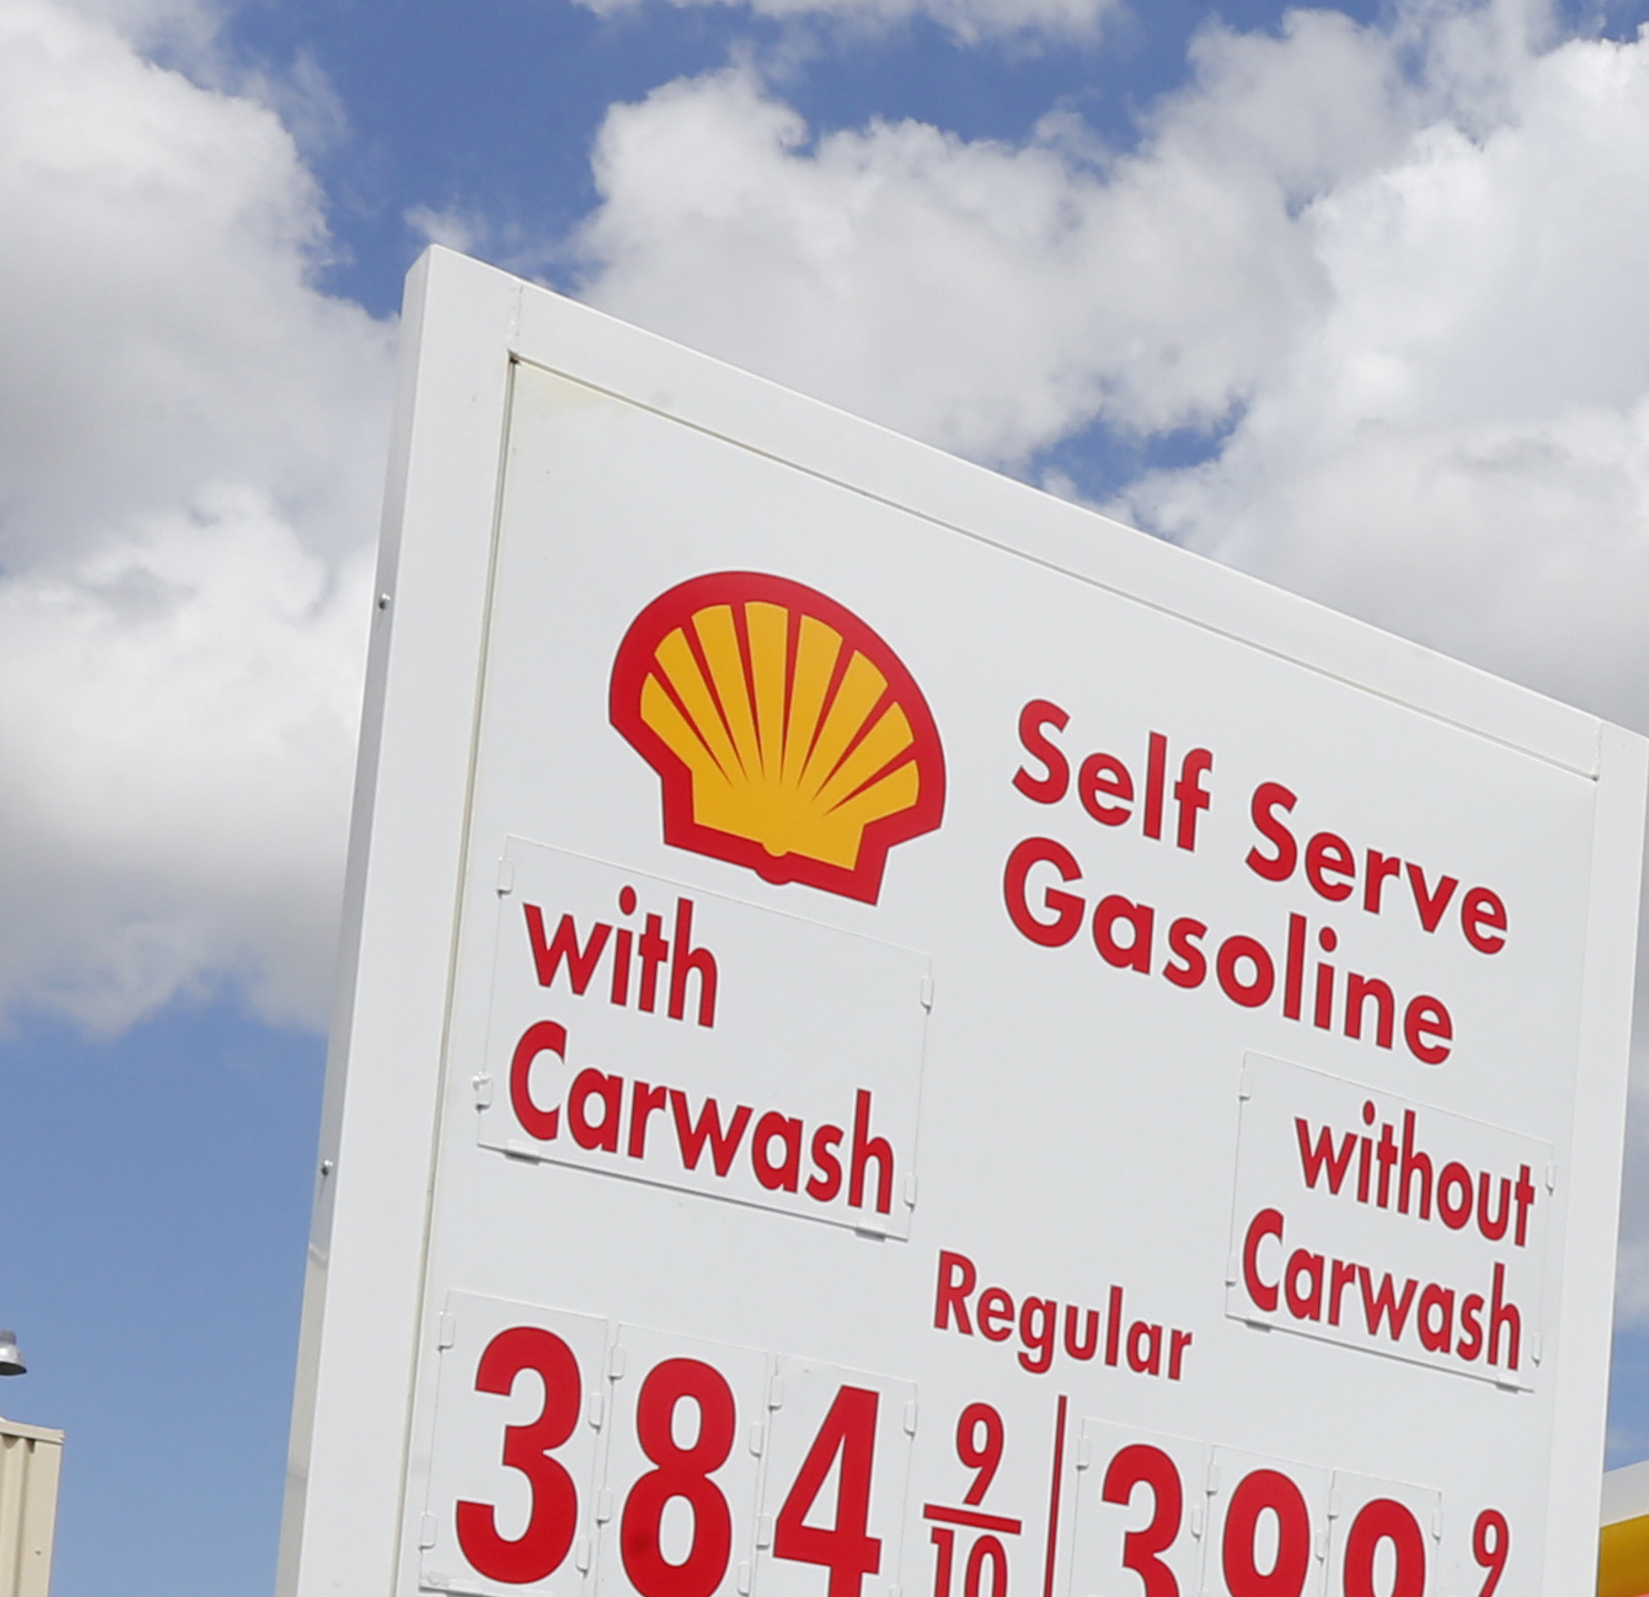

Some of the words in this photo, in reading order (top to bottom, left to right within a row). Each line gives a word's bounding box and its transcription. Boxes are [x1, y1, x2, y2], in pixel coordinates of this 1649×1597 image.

[1012, 698, 1213, 852] Self
[1245, 780, 1508, 955] Serve
[523, 885, 719, 1029] with
[1003, 836, 1454, 1066] Gasoline
[509, 1019, 895, 1215] Carwash
[1295, 1099, 1536, 1247] without
[934, 1249, 1193, 1381] Regular
[1243, 1207, 1522, 1371] Carwash
